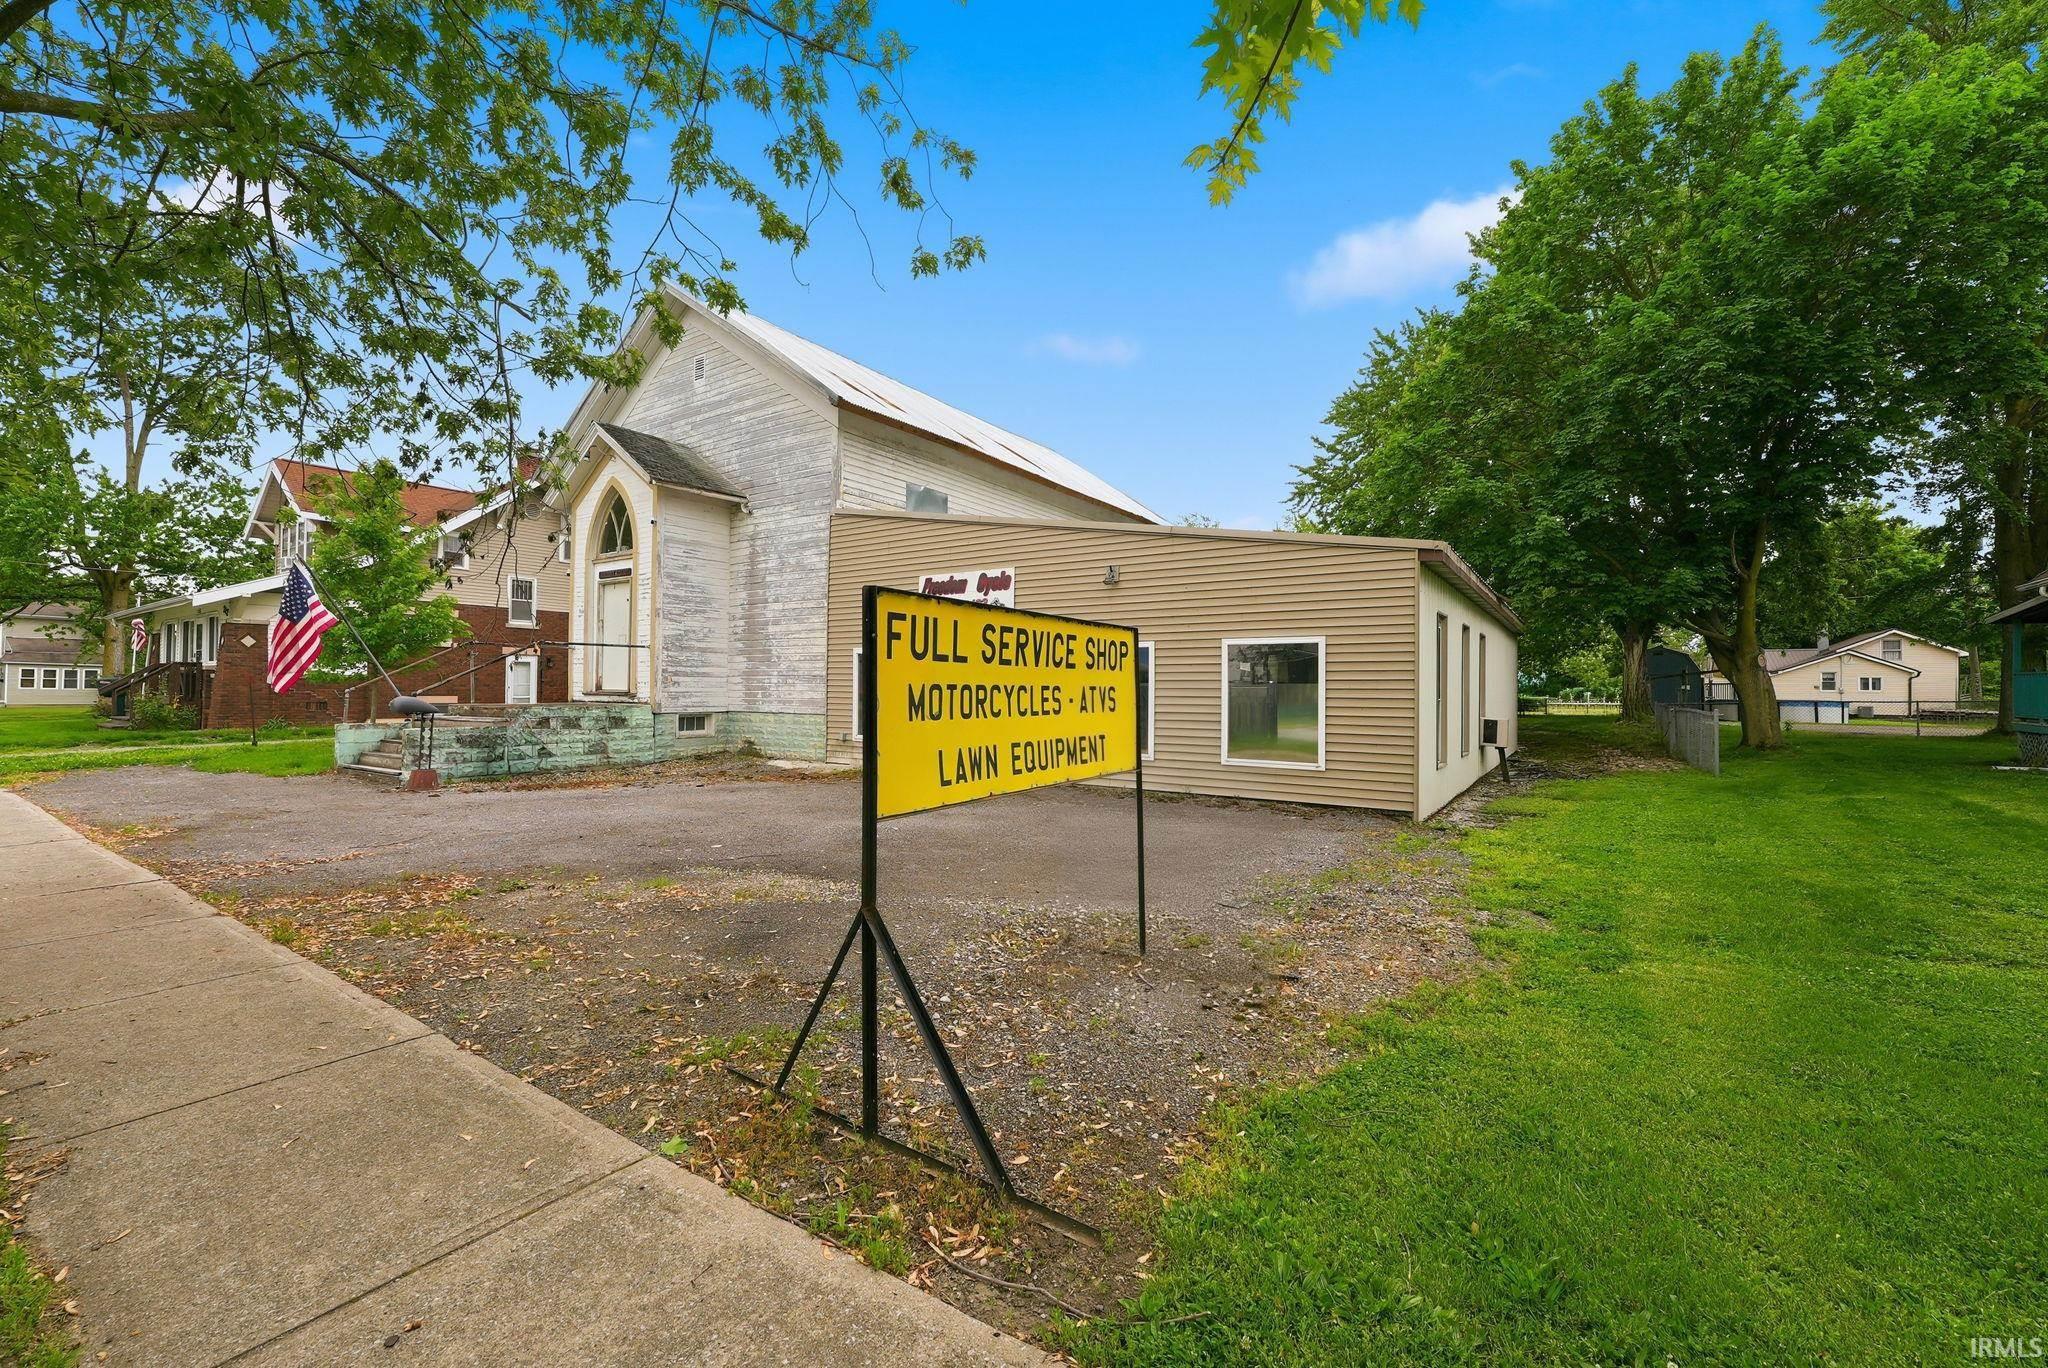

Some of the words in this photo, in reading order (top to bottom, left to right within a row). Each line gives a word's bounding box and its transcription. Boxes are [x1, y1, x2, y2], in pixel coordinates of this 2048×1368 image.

[886, 611, 968, 664] FULL
[981, 623, 1077, 670] SERVICE
[1085, 636, 1129, 672] SHOP
[908, 683, 1062, 722] MOTORCYCLES
[1079, 686, 1116, 713] ATVS
[938, 744, 998, 787] LAWN
[1010, 734, 1106, 776] EQUIPMENT
